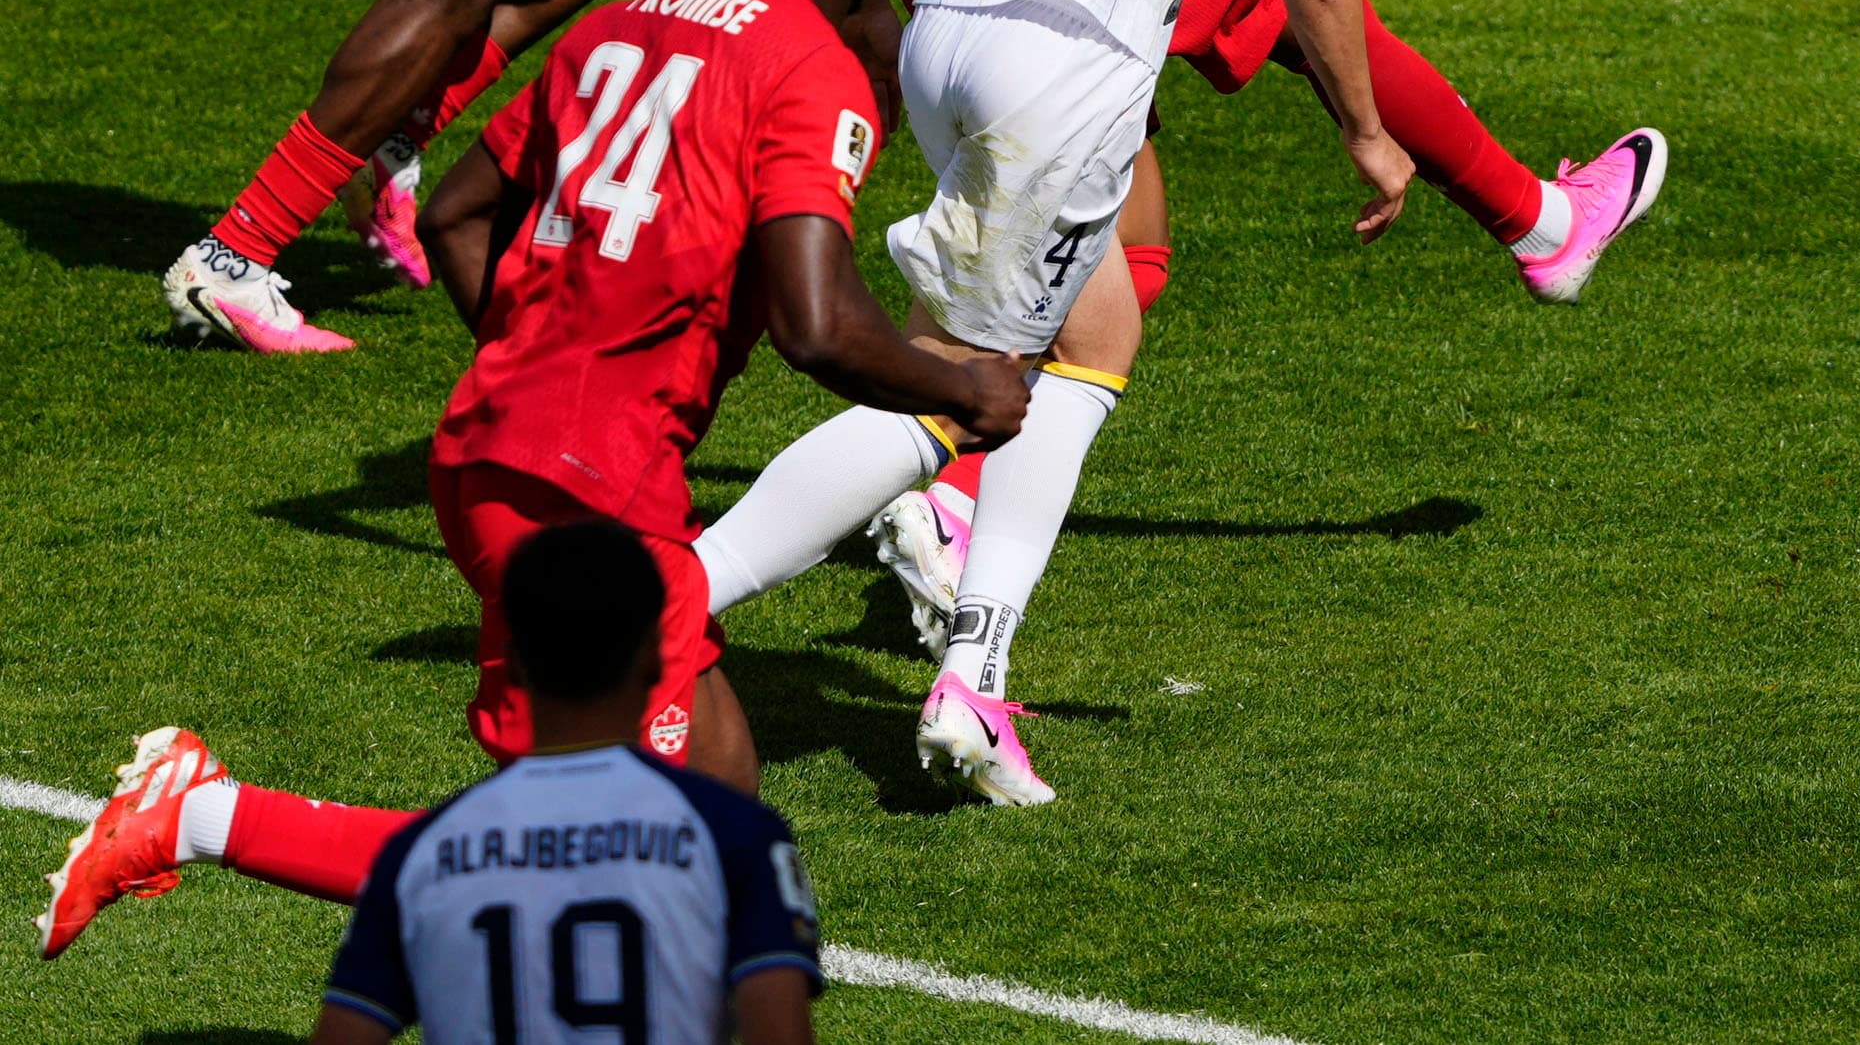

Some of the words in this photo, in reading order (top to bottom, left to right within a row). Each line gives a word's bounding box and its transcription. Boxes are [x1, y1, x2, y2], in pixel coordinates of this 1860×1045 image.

[533, 41, 705, 263] 24
[1043, 221, 1088, 289] 4
[986, 606, 1013, 662] TAPEDES
[470, 897, 648, 1045] 19
